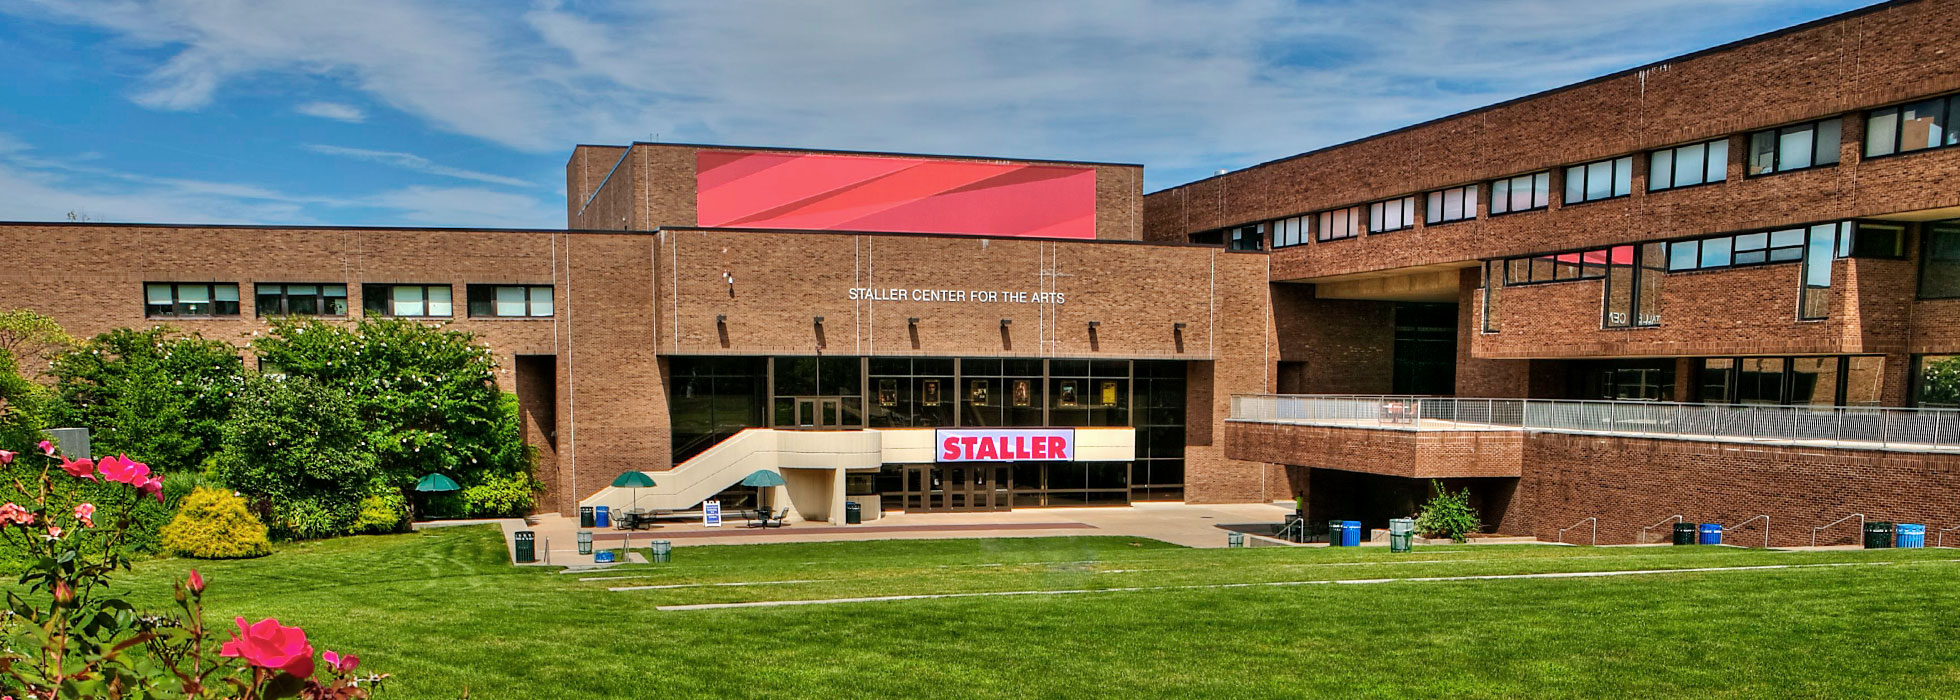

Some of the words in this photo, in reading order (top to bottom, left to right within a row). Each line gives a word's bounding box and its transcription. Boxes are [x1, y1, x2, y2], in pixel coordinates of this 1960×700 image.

[848, 288, 908, 301] STALLER
[912, 289, 966, 302] CENTER
[970, 290, 998, 303] FOR
[1002, 291, 1027, 303] THE
[1031, 292, 1065, 304] ARTS
[943, 436, 1067, 460] STALLER
